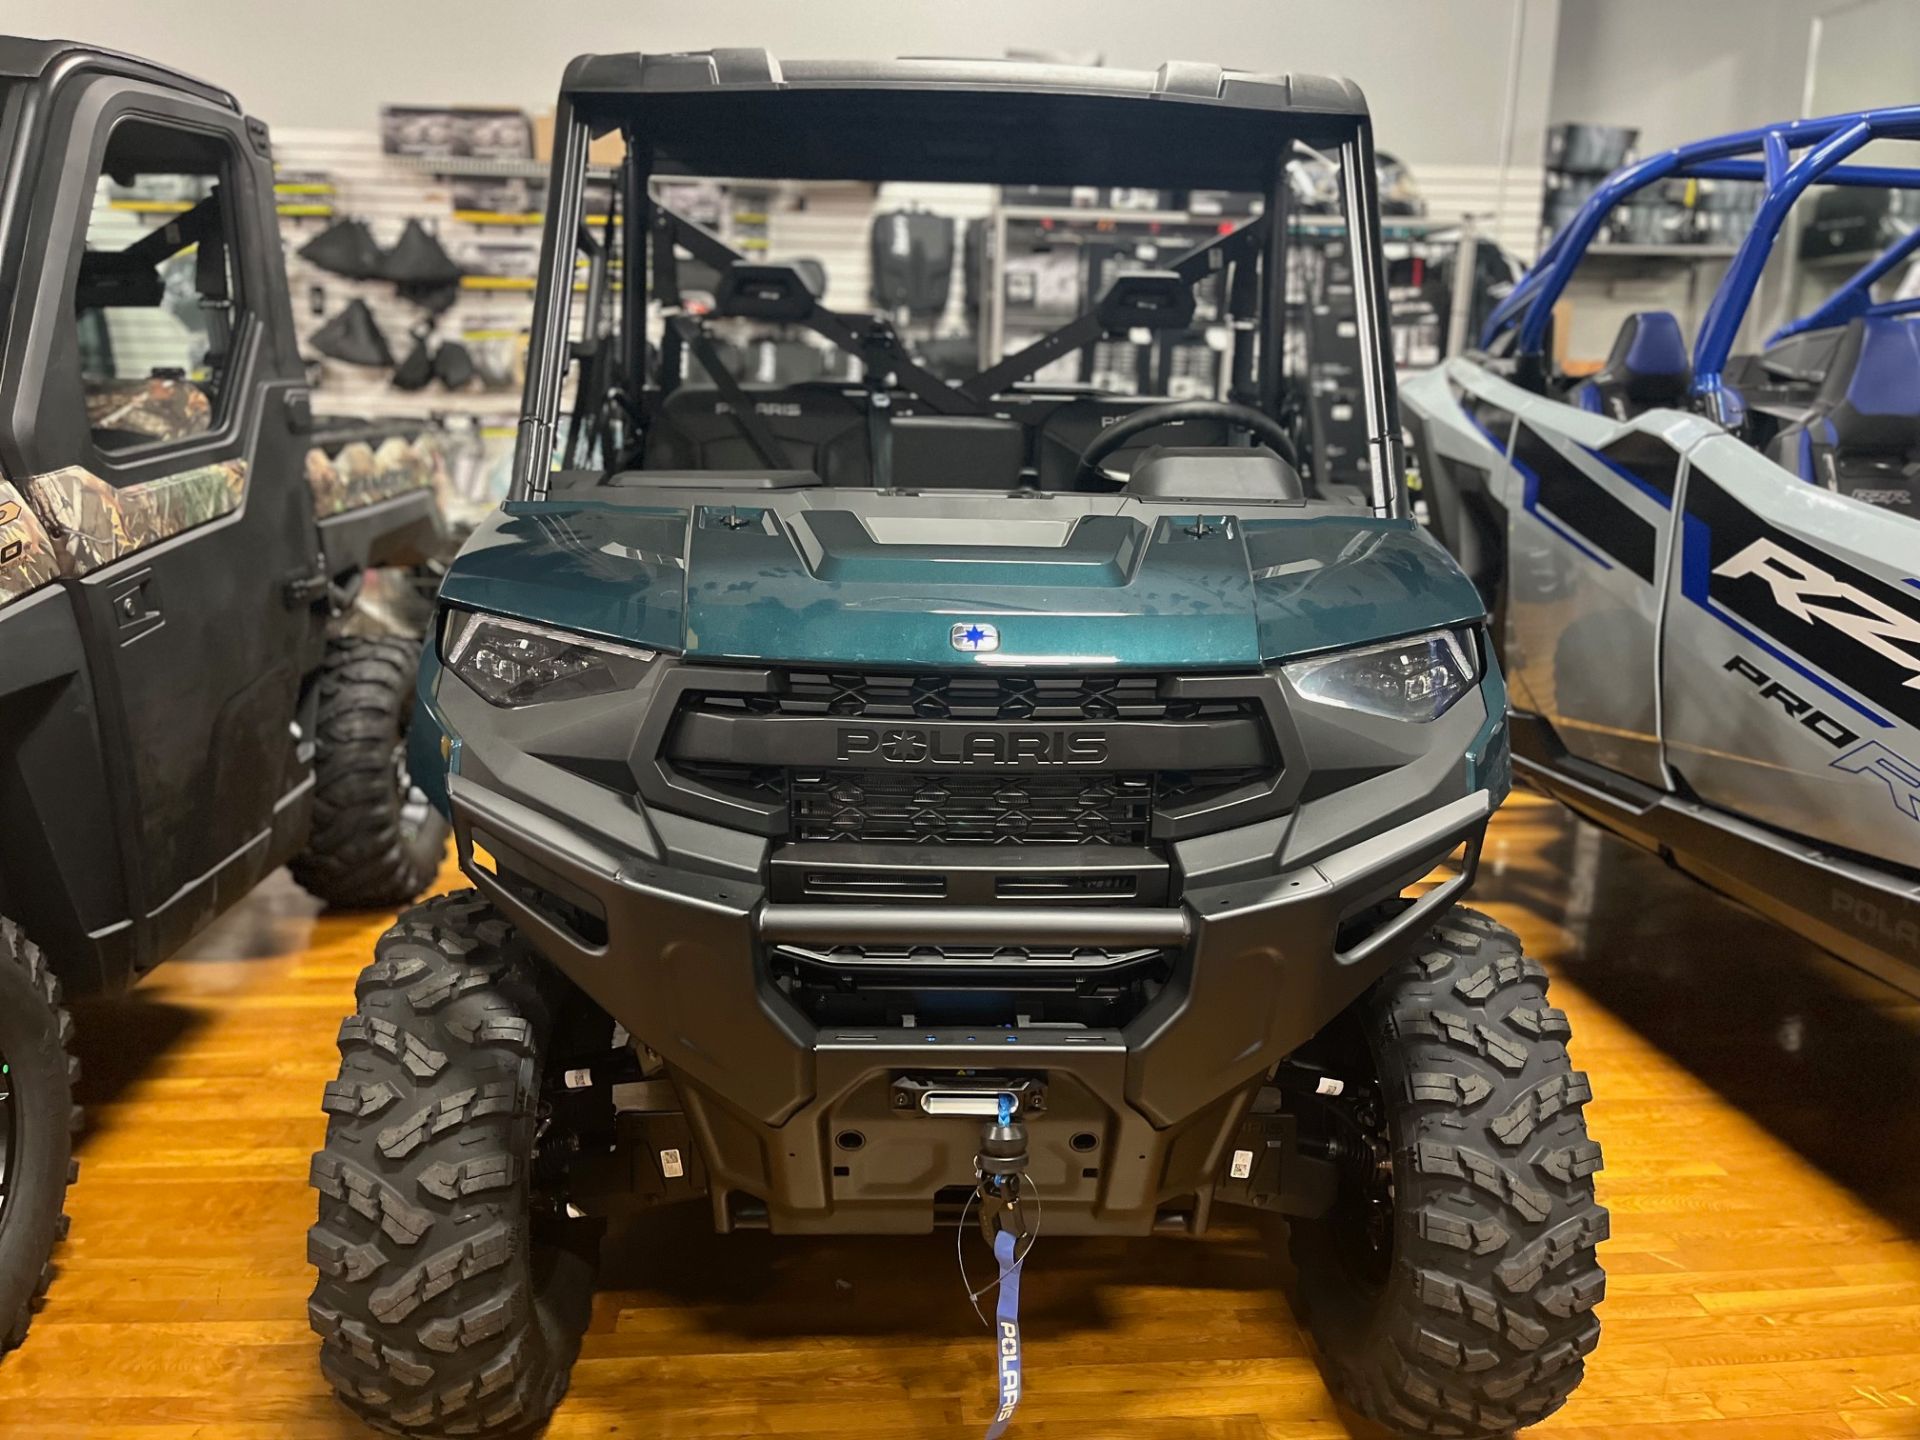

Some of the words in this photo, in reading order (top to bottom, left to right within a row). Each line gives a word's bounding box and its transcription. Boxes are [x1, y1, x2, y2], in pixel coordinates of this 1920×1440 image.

[1711, 537, 1920, 690] RZ
[837, 728, 1109, 765] POLARIS
[1723, 655, 1860, 749] PRO
[998, 1322, 1018, 1422] POLARIS
